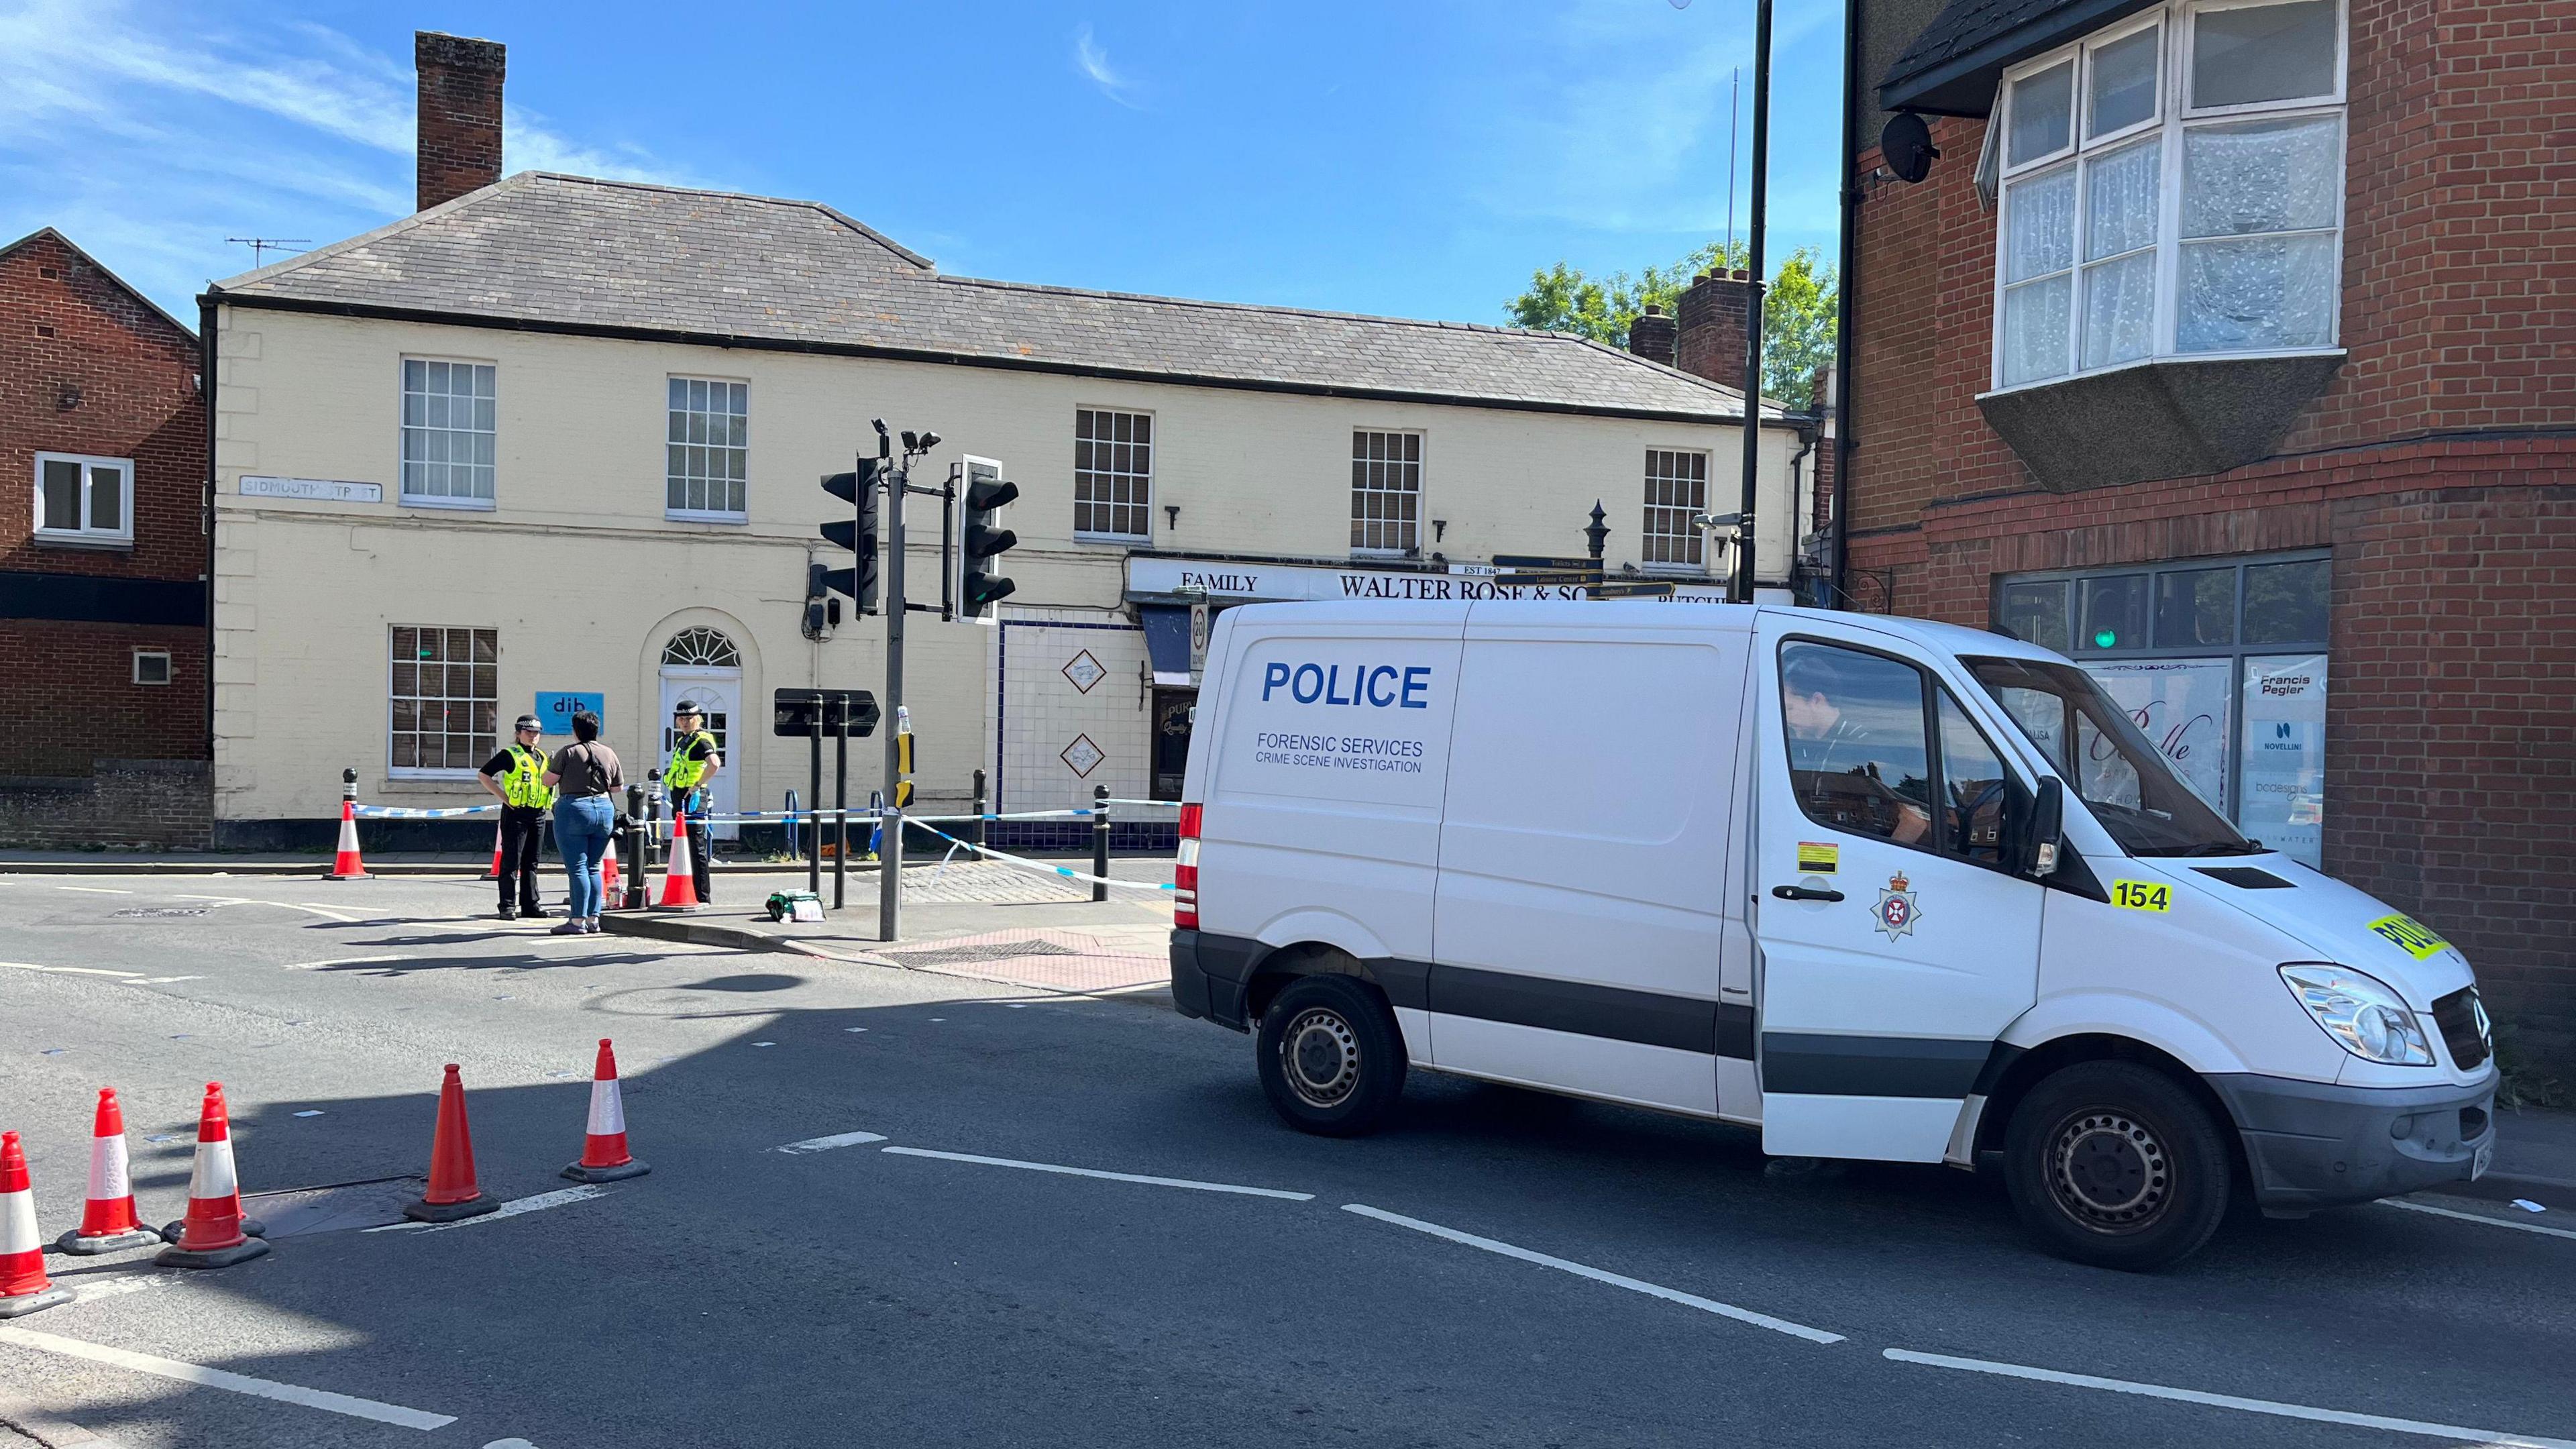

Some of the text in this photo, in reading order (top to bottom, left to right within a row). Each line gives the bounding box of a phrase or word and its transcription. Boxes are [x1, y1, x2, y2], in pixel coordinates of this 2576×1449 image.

[1464, 566, 1501, 576] EST 1847
[1181, 572, 1258, 592] FAMILY
[1340, 575, 1452, 600] WALTER
[1533, 585, 1550, 600] &
[1195, 621, 1203, 637] 20
[1262, 662, 1432, 708] POLICE
[2260, 675, 2310, 685] Francis
[2261, 685, 2304, 696] Pegler
[553, 697, 586, 712] dib
[1257, 733, 1423, 757] FORENSIC SERVICES
[2264, 743, 2302, 751] NOVELLINI
[1256, 751, 1422, 773] CRIME SCENE INVESTIGATION
[2255, 782, 2308, 802] bcdesigns
[2116, 882, 2167, 910] 154
